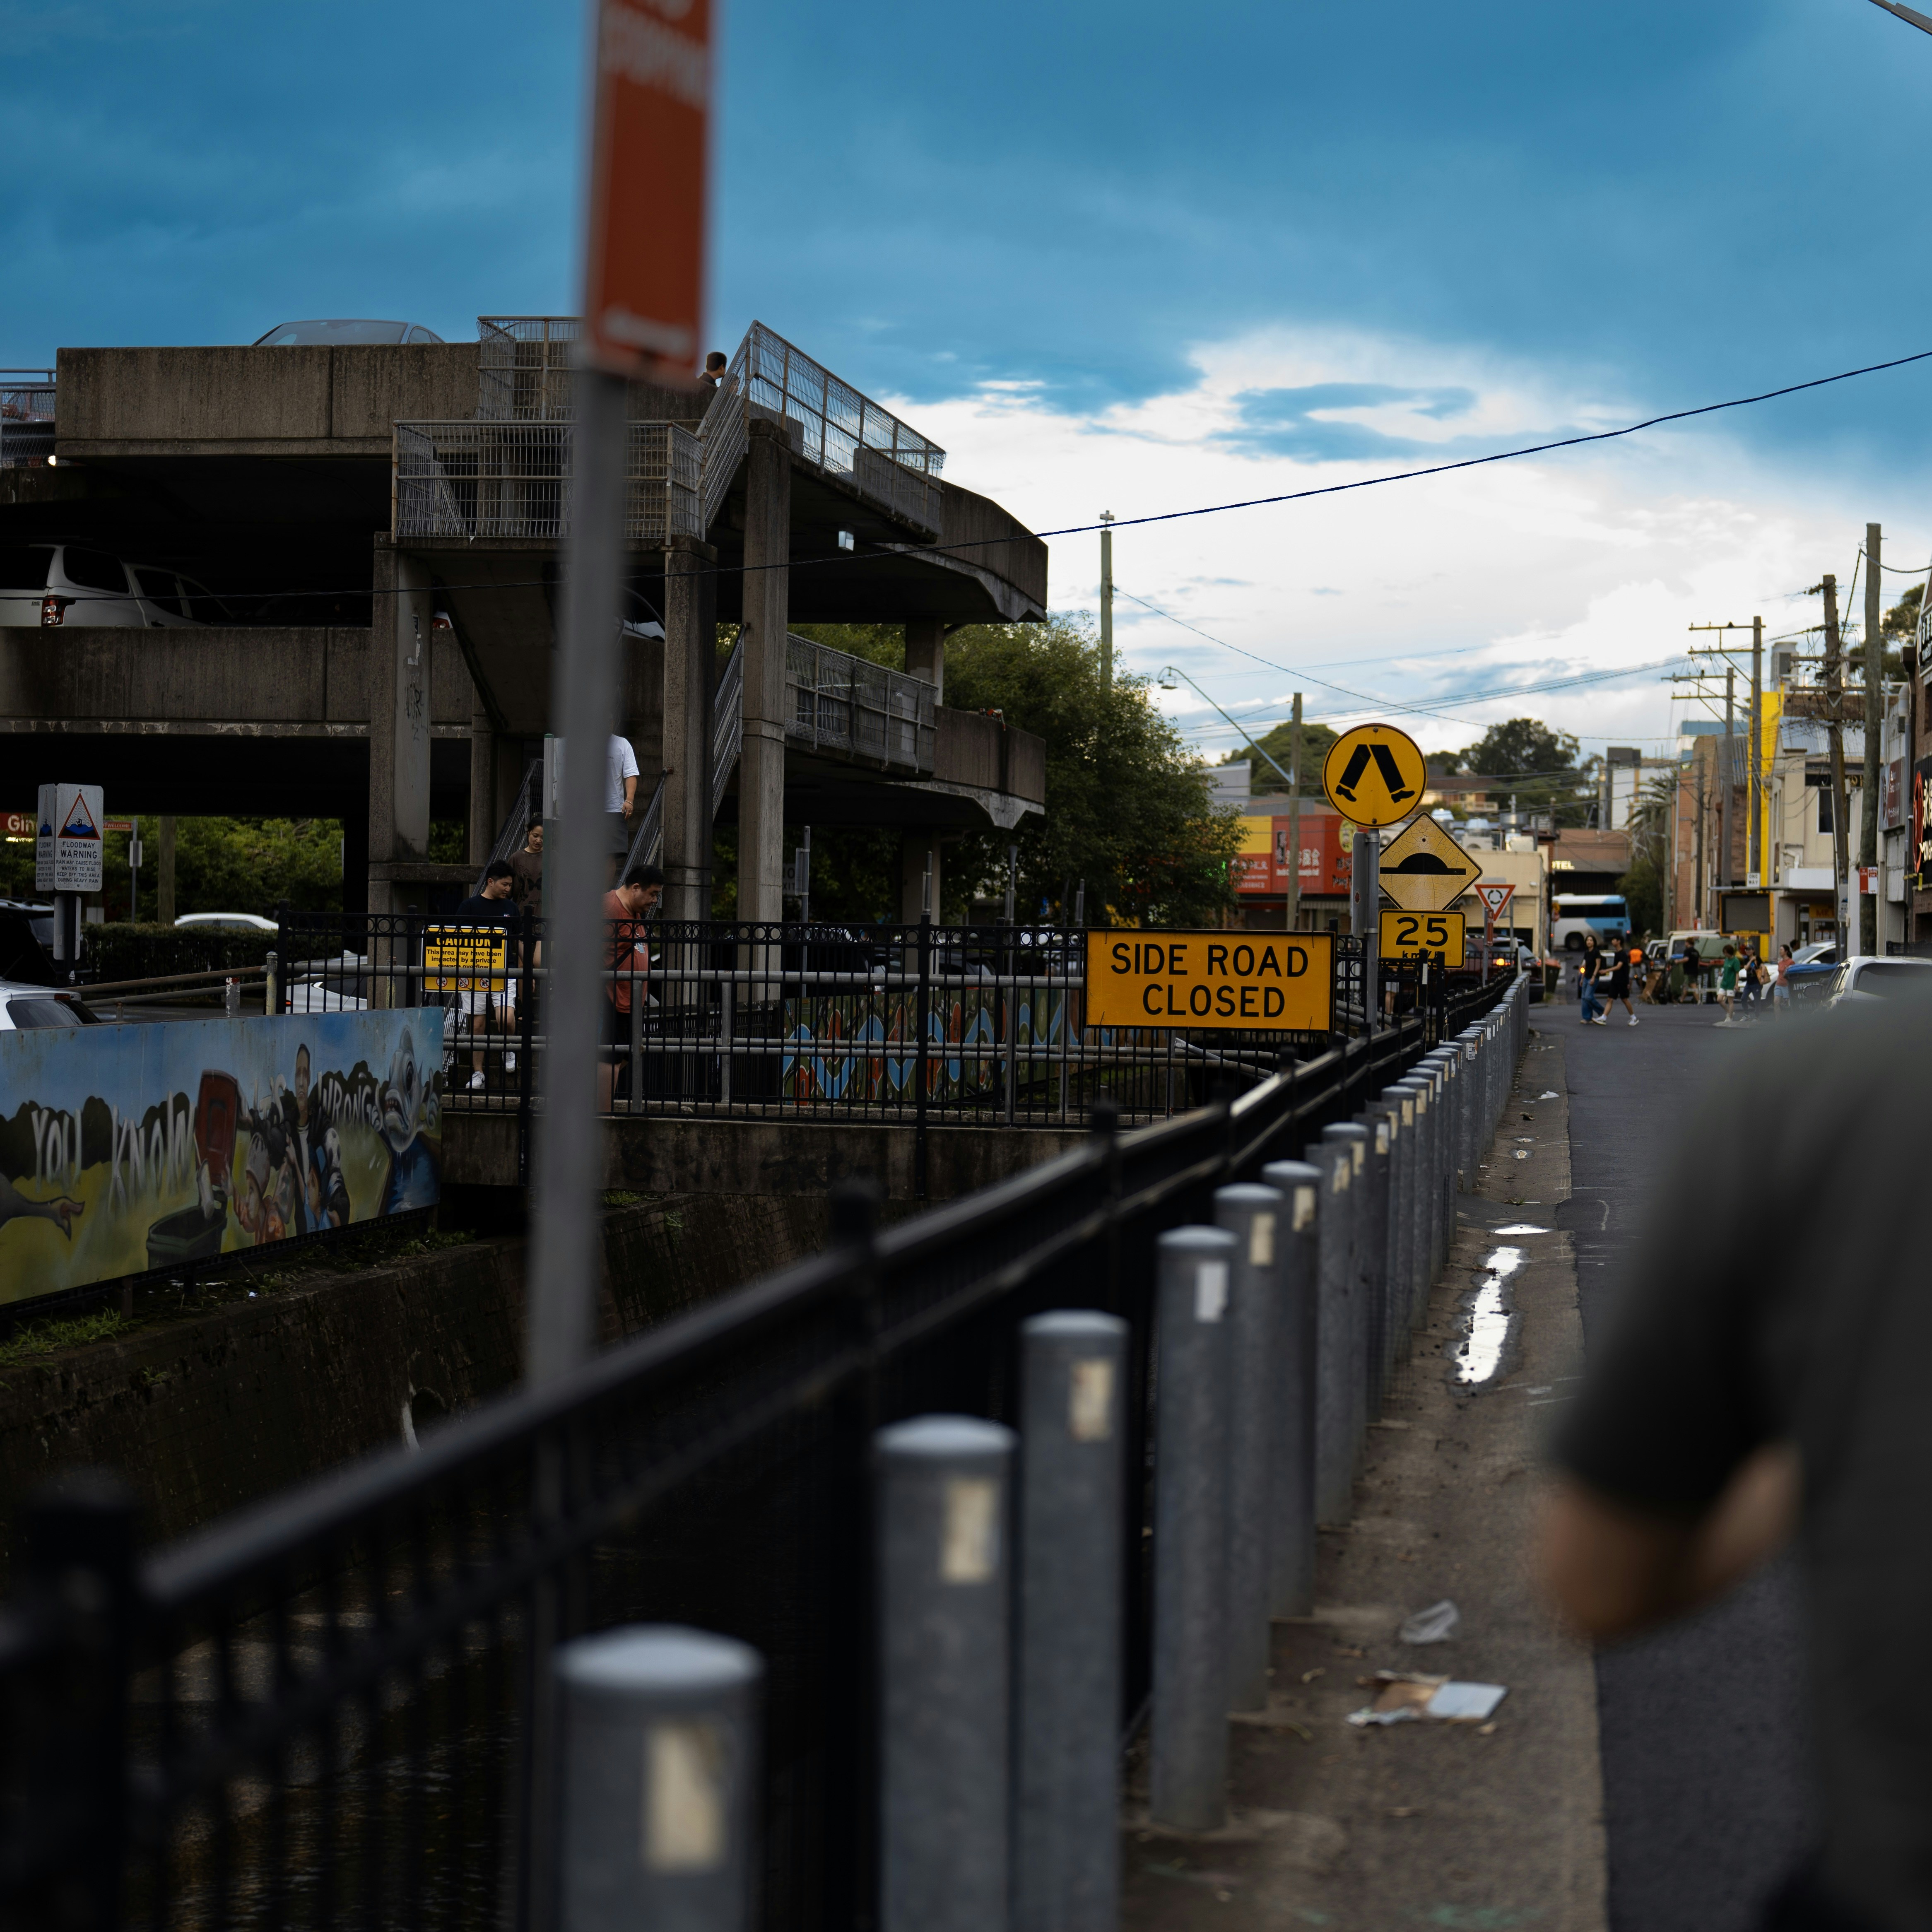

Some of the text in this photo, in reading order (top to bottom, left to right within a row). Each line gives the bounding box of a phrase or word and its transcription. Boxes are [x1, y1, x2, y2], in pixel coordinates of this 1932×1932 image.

[7, 814, 37, 832] Gin
[39, 850, 52, 858] WARNING
[61, 850, 97, 858] WARNING
[1551, 861, 1575, 870] TEL
[783, 882, 795, 891] XIT
[1396, 917, 1448, 947] 25
[1111, 942, 1308, 977] SIDE ROAD
[1143, 983, 1285, 1017] CLOSED
[31, 1108, 82, 1192] YOU
[109, 1090, 197, 1209] KNOW
[317, 1071, 372, 1127] WRONG
